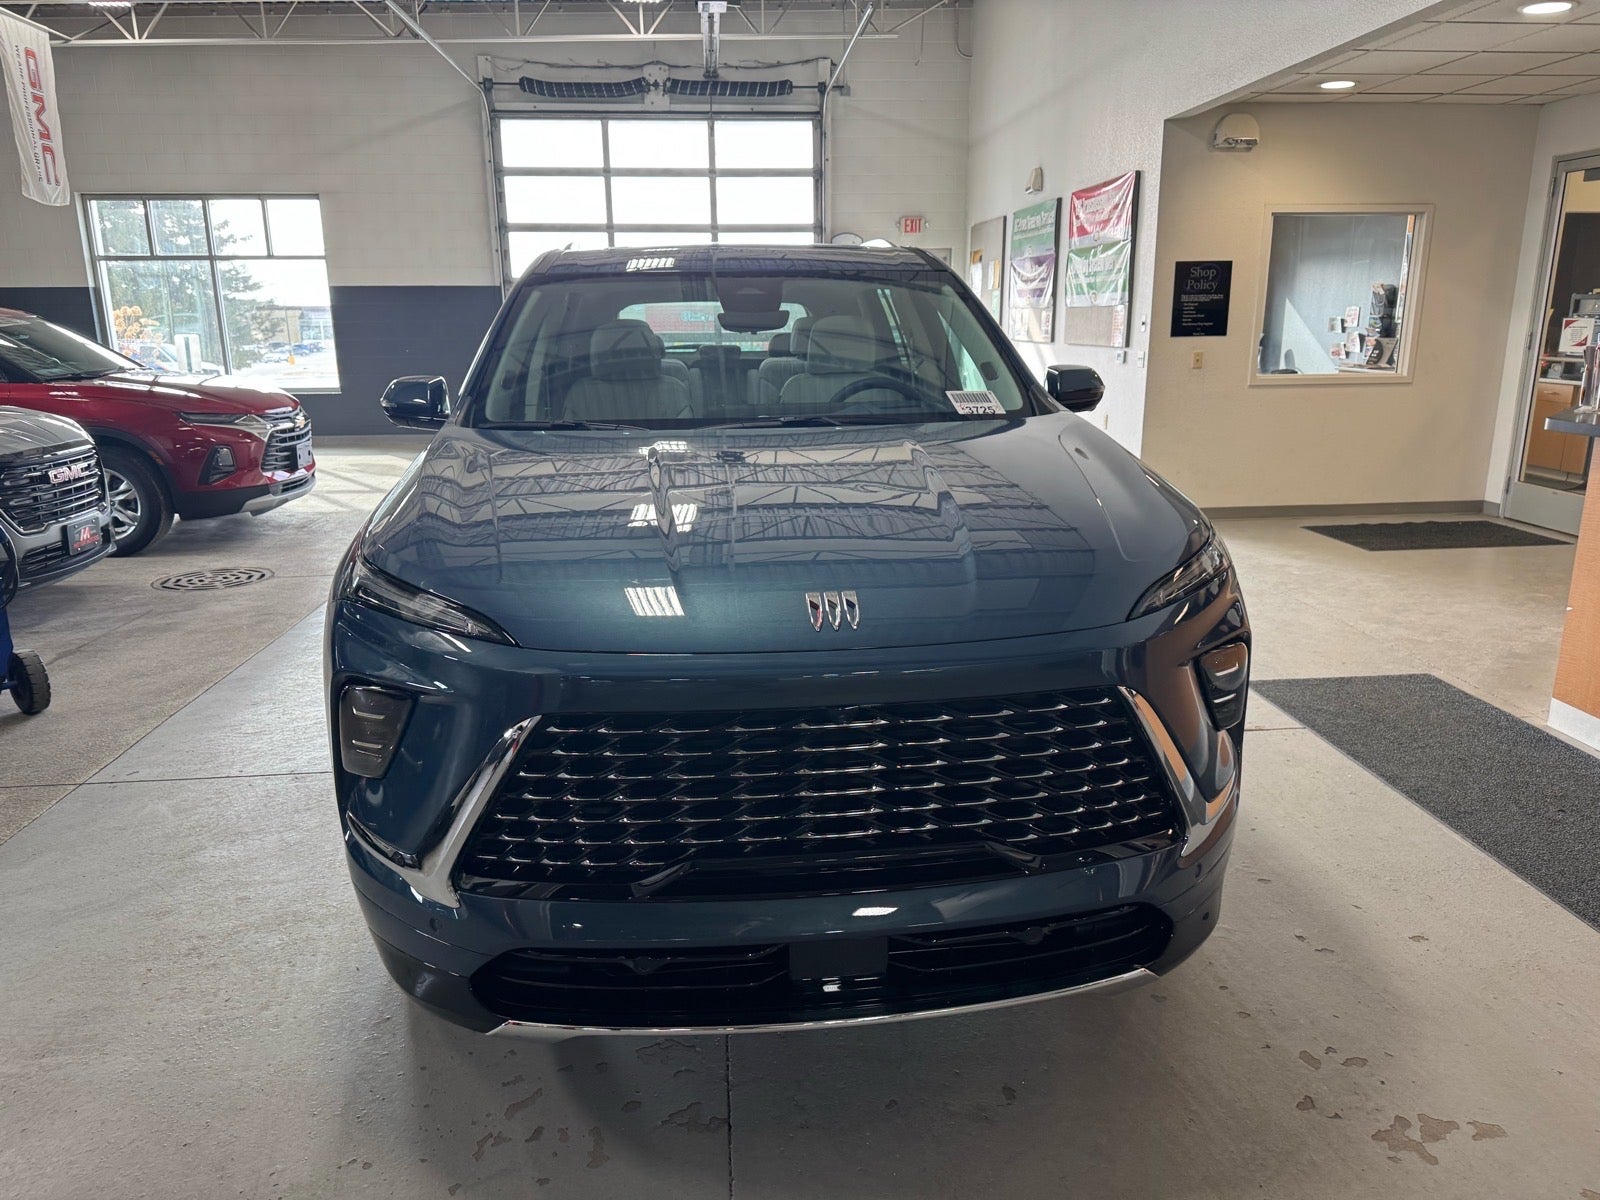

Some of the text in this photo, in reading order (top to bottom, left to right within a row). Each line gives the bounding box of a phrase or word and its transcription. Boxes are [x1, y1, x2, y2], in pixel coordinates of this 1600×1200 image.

[25, 47, 60, 186] GMC
[904, 217, 922, 233] EXIT
[1190, 266, 1216, 280] Shop
[1187, 280, 1217, 292] Policy
[48, 463, 88, 484] GMC
